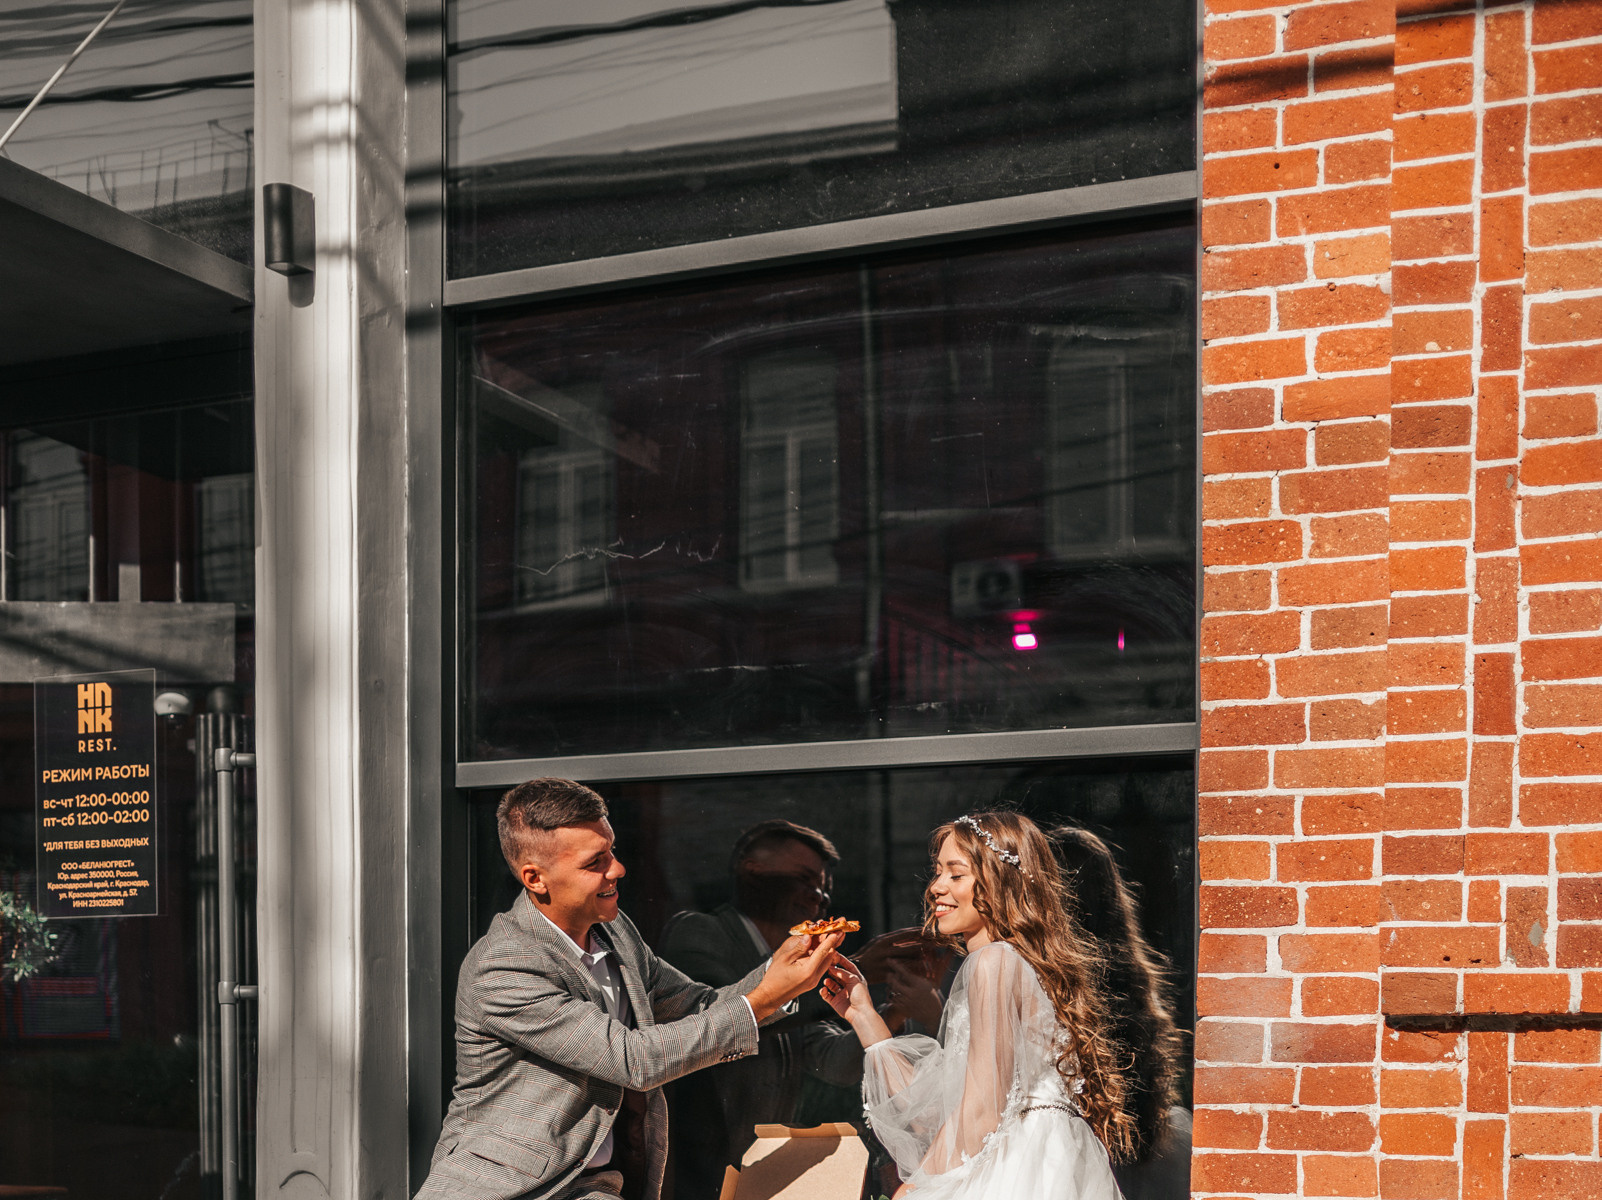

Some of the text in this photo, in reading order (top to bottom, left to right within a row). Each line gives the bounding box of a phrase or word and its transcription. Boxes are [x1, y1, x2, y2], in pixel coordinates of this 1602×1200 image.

[78, 738, 117, 753] REST.
[42, 764, 149, 783] РЕЖИМ РАБОТЫ
[43, 791, 149, 809] вс-чт 12:00-00:00
[43, 809, 149, 827] пт-сб 12:00-02:00
[64, 840, 84, 850] ТЕБЯ
[85, 839, 100, 849] БЕЗ
[101, 837, 149, 849] ВЫХОДНЫХ
[61, 862, 78, 870] ООО
